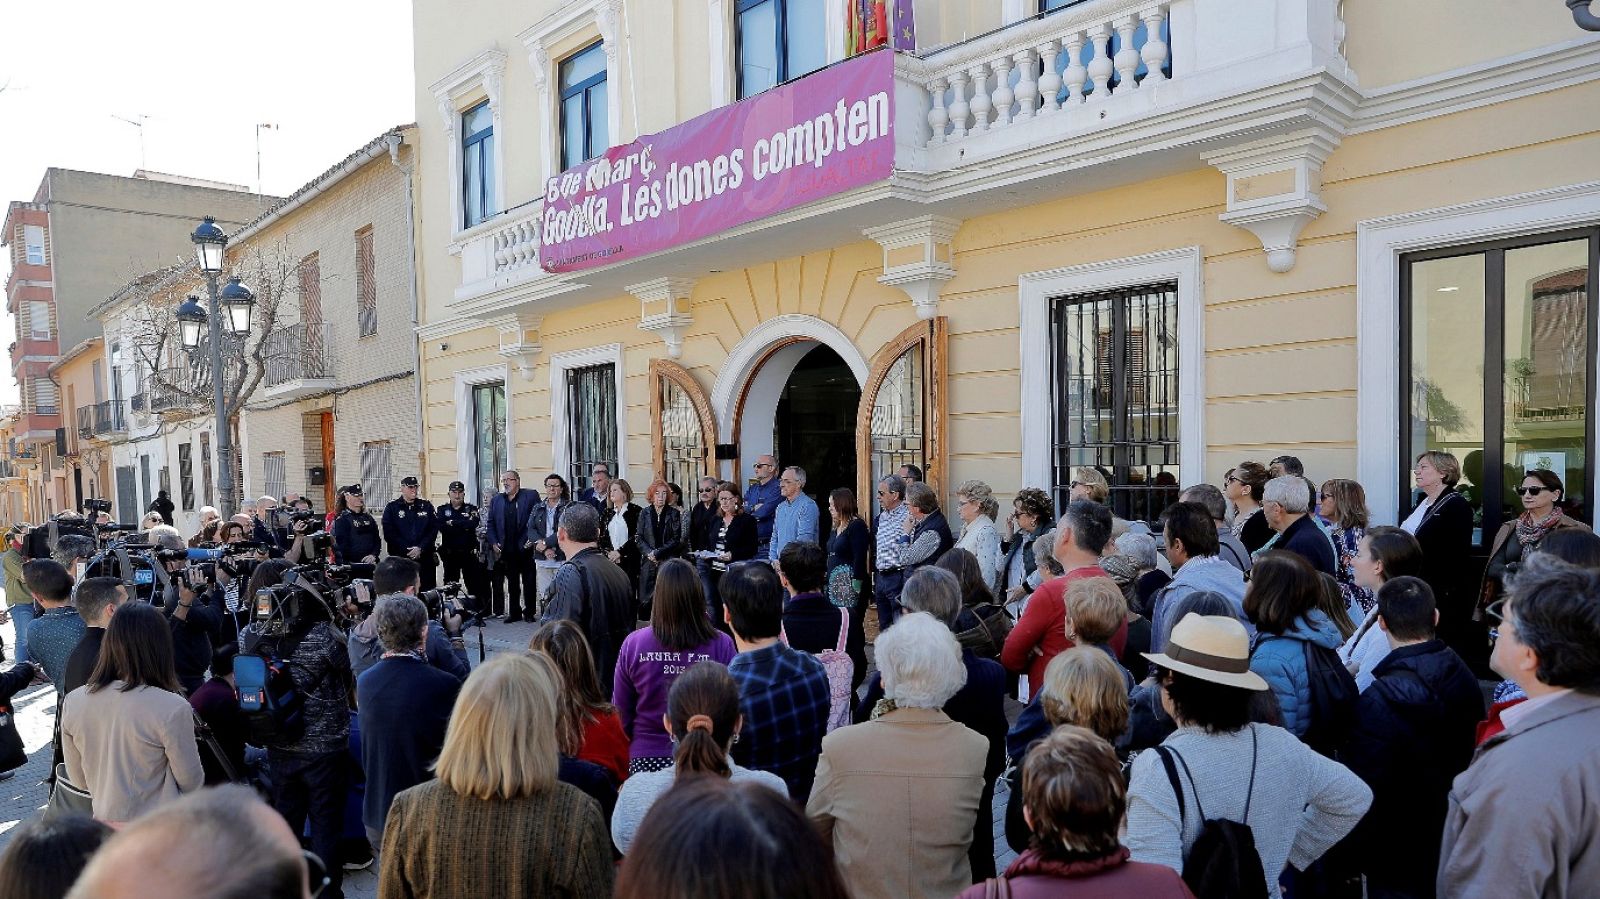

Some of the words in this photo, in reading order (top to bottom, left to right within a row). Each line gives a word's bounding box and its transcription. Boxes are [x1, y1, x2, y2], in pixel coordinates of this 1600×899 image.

[621, 180, 662, 226] Les
[665, 148, 744, 212] dones
[752, 91, 889, 181] compten
[135, 570, 152, 582] tve
[639, 651, 681, 662] LAURA
